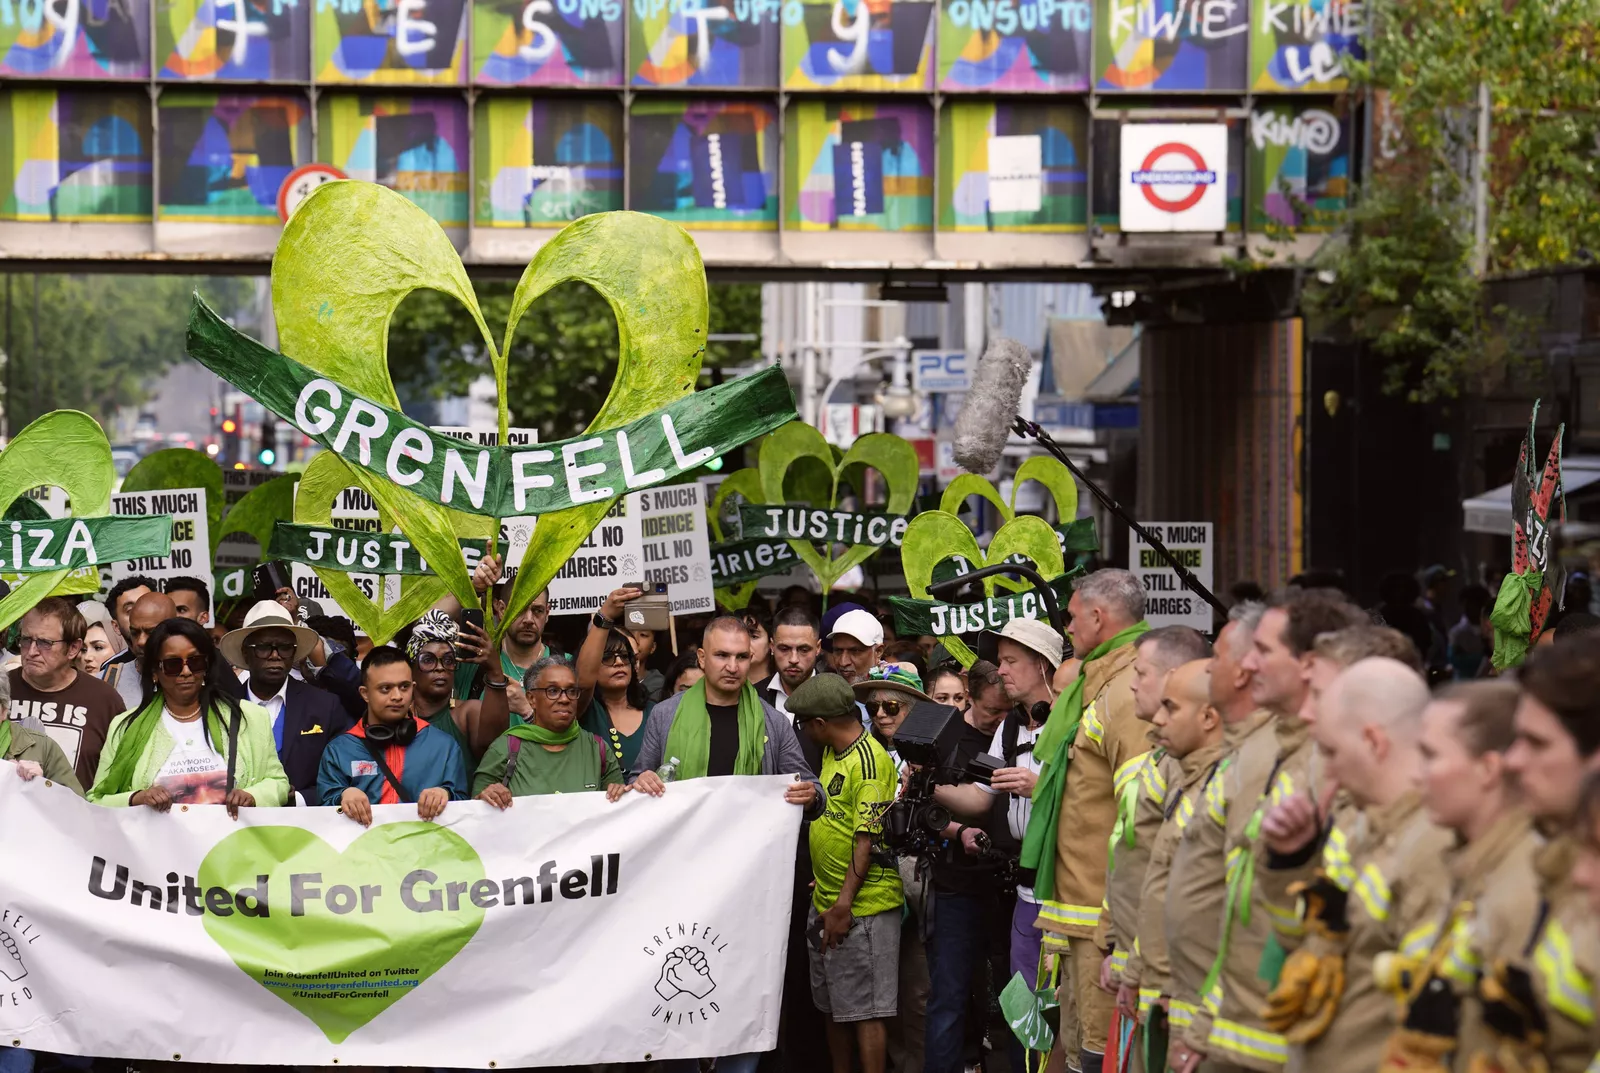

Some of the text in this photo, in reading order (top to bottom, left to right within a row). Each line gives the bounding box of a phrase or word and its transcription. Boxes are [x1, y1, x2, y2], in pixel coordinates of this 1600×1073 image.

[919, 354, 966, 375] PC
[112, 493, 198, 516] THIS MUCH
[653, 487, 697, 510] MUCH
[602, 525, 624, 548] NO
[1167, 526, 1206, 544] MUCH
[171, 548, 192, 569] NO
[673, 538, 693, 559] NO
[296, 576, 374, 600] CHAES
[1142, 573, 1176, 591] STILL
[10, 699, 88, 727] HIS IS
[170, 757, 211, 767] RAYMOND
[88, 852, 620, 918] United For Grenfell
[643, 922, 729, 957] GRENFELL
[264, 967, 419, 980] Join @GrenfellUnited on Twitter
[263, 978, 419, 991] www.supportgrenfellunited.org
[292, 990, 389, 999] #UnitedForGrenfell
[651, 1001, 720, 1025] UNITED
